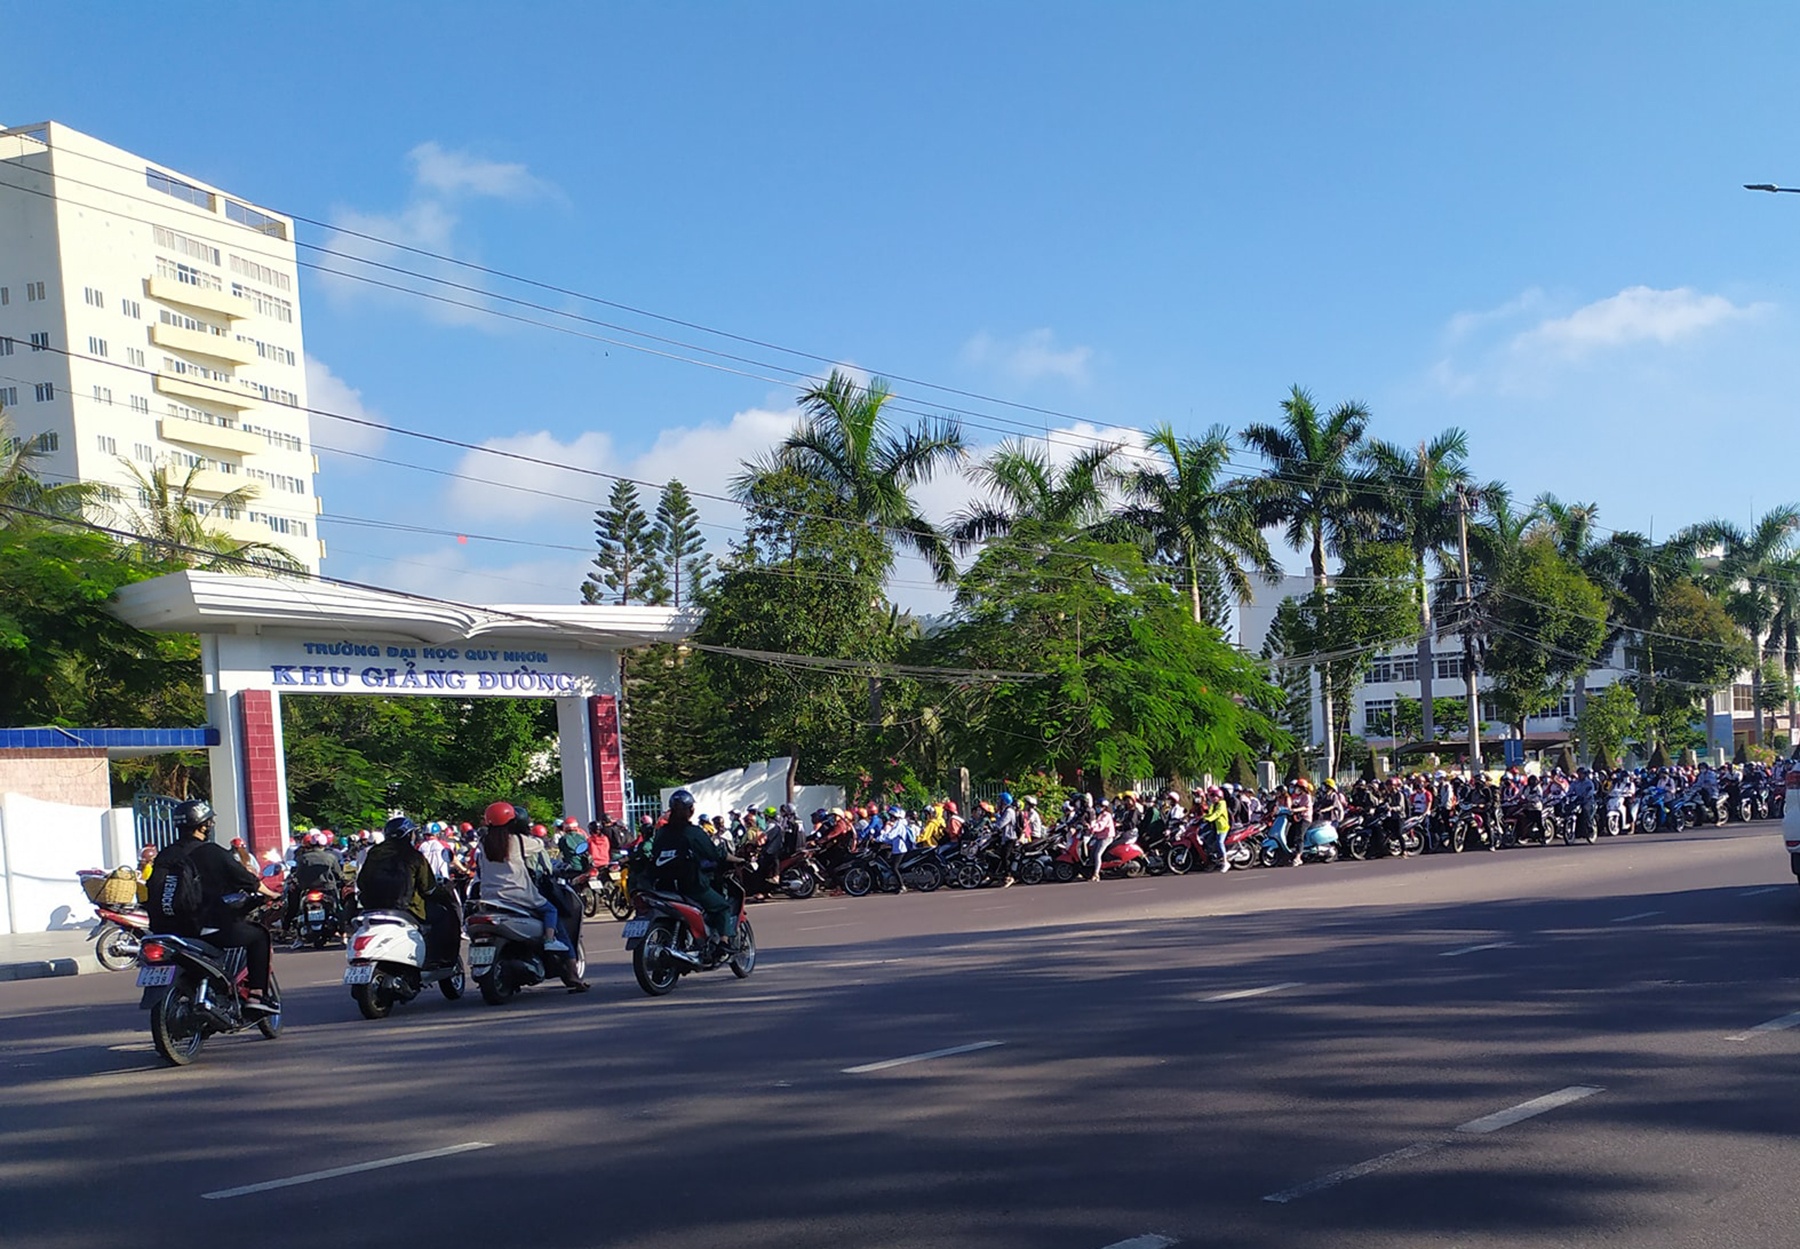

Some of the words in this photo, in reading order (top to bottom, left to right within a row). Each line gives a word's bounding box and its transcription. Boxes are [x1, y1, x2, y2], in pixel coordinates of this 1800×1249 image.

[304, 640, 380, 657] TRƯỜNG
[386, 646, 416, 662] ĐẠI
[423, 648, 459, 663] HỌC
[465, 649, 499, 661] QUY
[504, 651, 549, 663] NHƠN
[270, 665, 352, 687] KHU
[361, 661, 467, 689] GIẢNG
[477, 665, 577, 691] ĐƯỜNG
